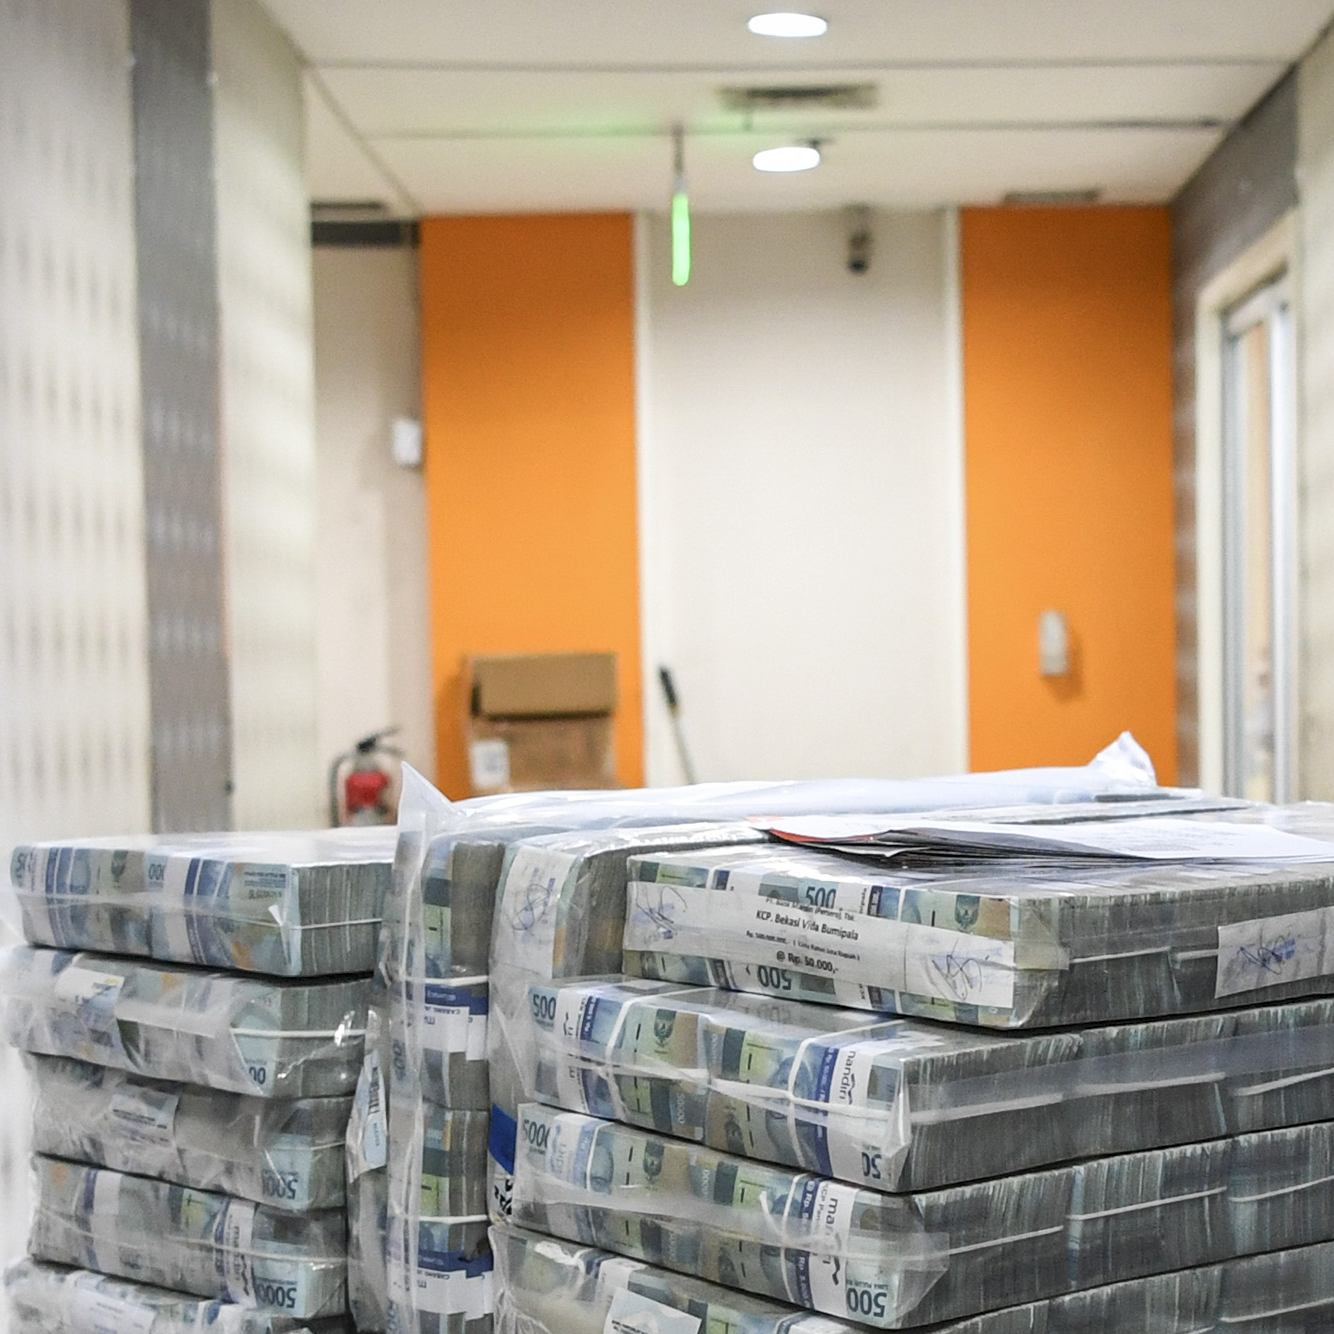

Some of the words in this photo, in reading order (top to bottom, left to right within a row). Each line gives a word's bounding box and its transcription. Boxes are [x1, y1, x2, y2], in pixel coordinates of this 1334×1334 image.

[774, 912, 800, 928] Bekasi
[821, 923, 859, 941] Bumipala
[757, 965, 792, 991] 500
[532, 993, 557, 1020] 500
[847, 1287, 888, 1319] 500
